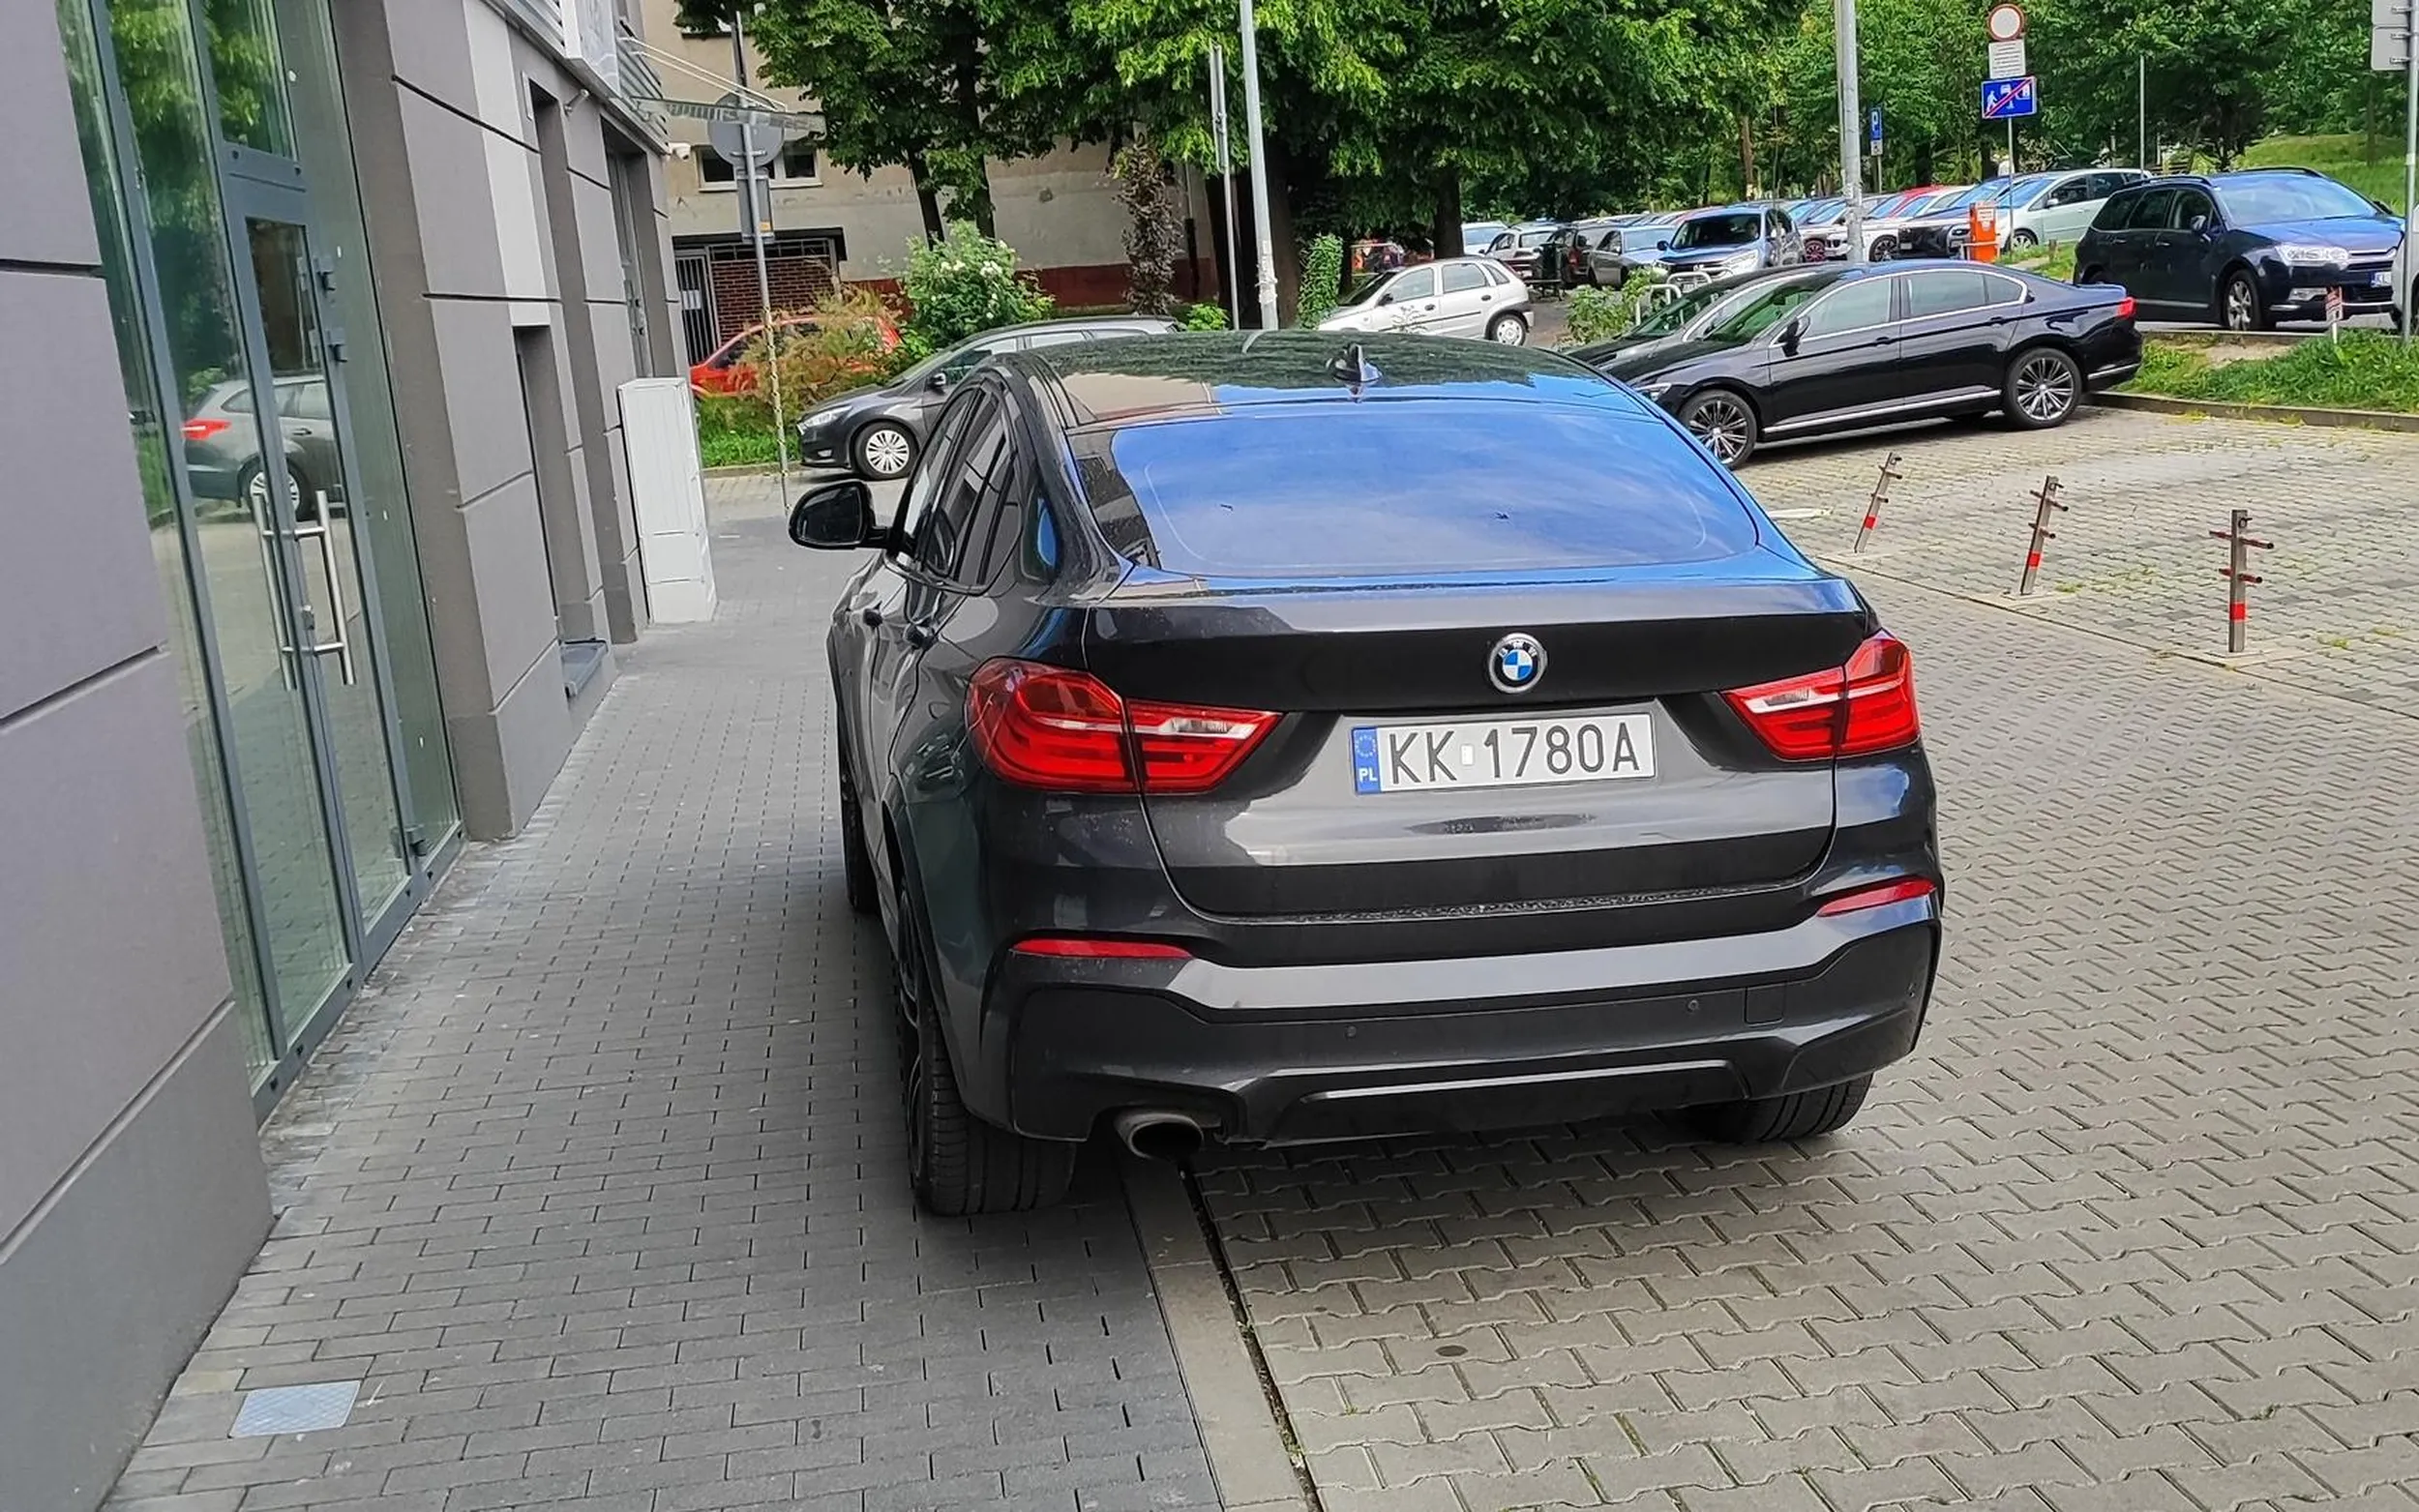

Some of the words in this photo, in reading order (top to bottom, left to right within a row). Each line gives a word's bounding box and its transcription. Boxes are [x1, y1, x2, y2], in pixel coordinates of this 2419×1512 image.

[1871, 110, 1879, 132] P
[1498, 640, 1538, 658] BMW
[1389, 731, 1457, 785] KK
[1483, 722, 1639, 778] 1780A
[1359, 767, 1378, 783] PL
